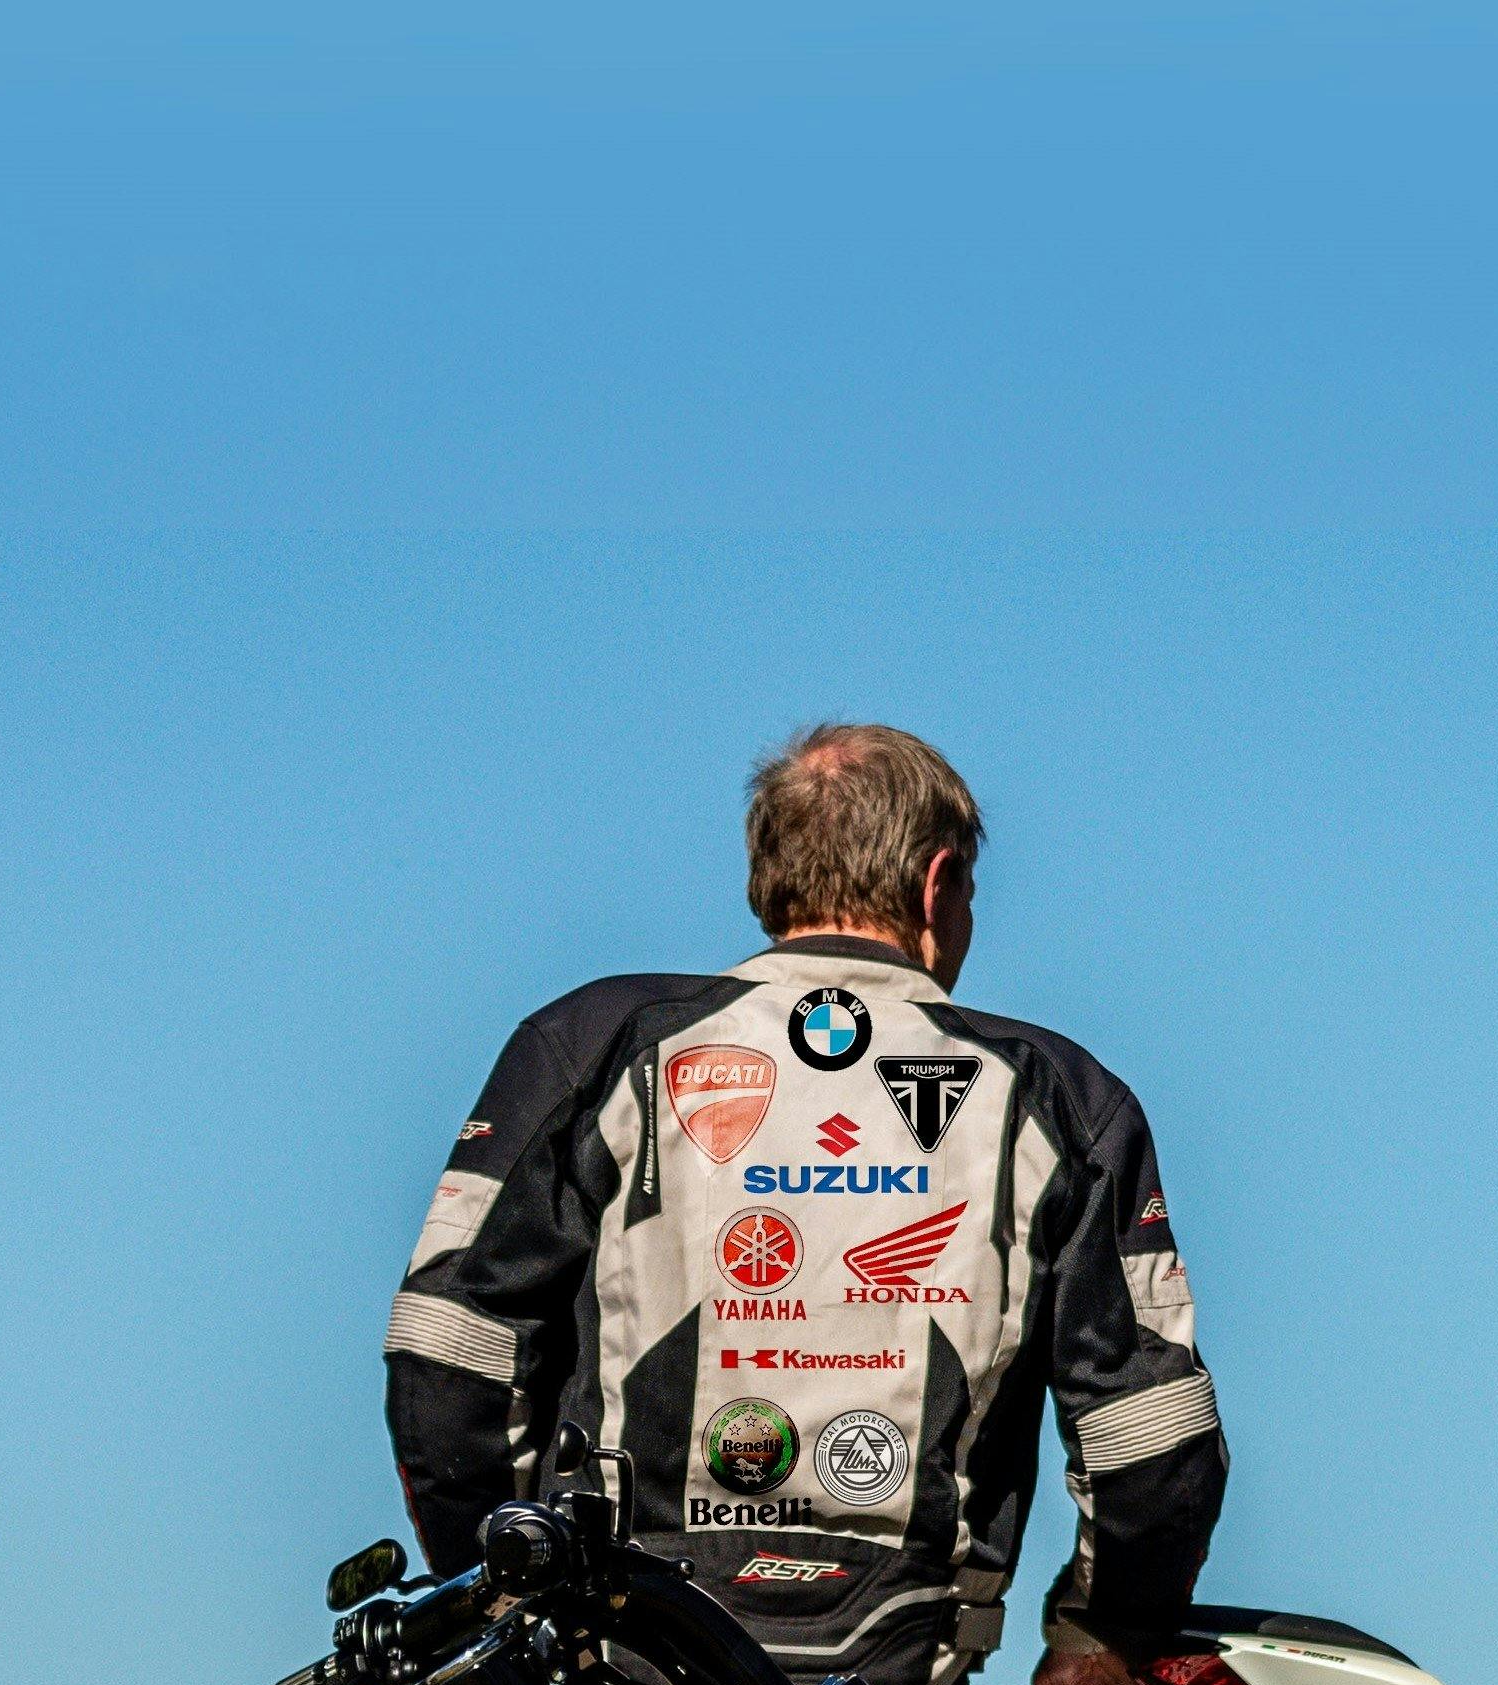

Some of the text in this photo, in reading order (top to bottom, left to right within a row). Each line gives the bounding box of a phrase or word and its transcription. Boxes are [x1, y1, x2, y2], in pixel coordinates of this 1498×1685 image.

[795, 989, 865, 1017] BMW
[675, 1063, 766, 1086] DUCATI
[900, 1064, 955, 1078] TRIUMPH
[644, 1137, 654, 1179] SERIES
[642, 1180, 653, 1195] IV
[743, 1165, 929, 1194] SUZUKI
[843, 1287, 973, 1304] HONDA
[712, 1299, 807, 1321] YAMAHA
[782, 1349, 906, 1370] Kawasaki
[819, 1414, 904, 1450] URAL MOTORCYCLES
[721, 1438, 782, 1453] Benelli
[689, 1497, 813, 1527] Benelli
[737, 1557, 841, 1582] RST
[1302, 1650, 1347, 1664] DUCATI
